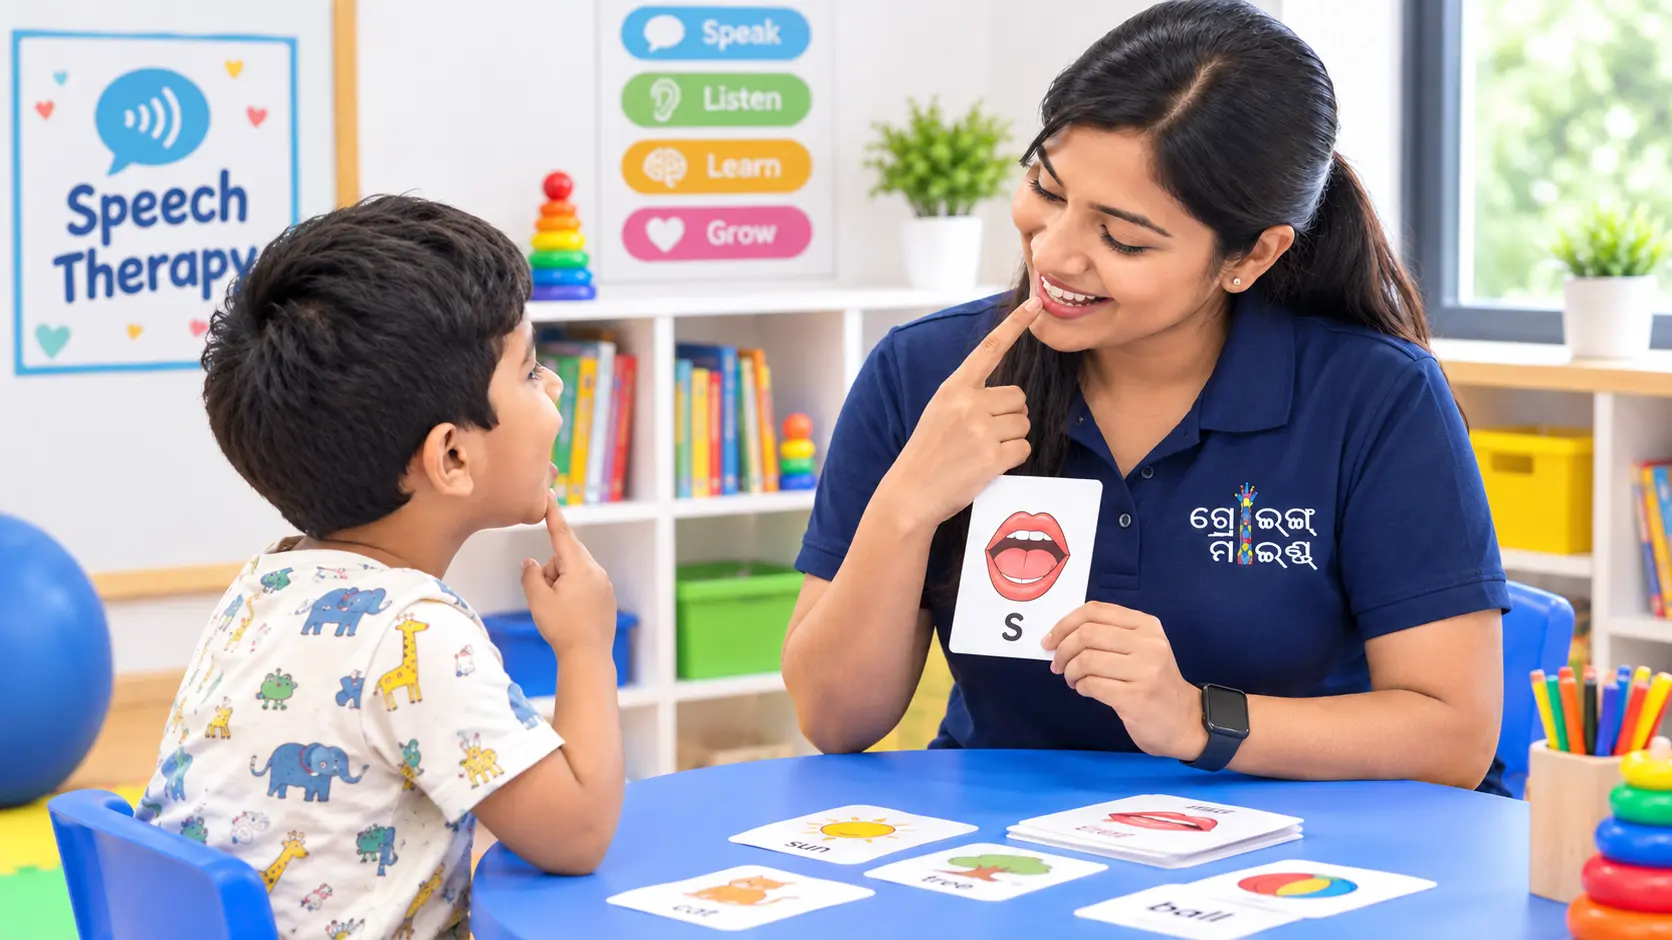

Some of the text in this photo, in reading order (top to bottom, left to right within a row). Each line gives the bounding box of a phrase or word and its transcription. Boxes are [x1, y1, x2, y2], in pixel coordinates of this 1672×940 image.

[702, 19, 781, 51] Speak
[703, 86, 783, 112] Listen
[707, 154, 782, 178] Learn
[67, 169, 248, 246] Speech
[707, 220, 777, 246] Grow
[52, 246, 257, 303] Therapy
[784, 841, 831, 853] sun
[921, 875, 974, 889] tree
[673, 904, 719, 917] cat
[1147, 901, 1234, 922] ball
